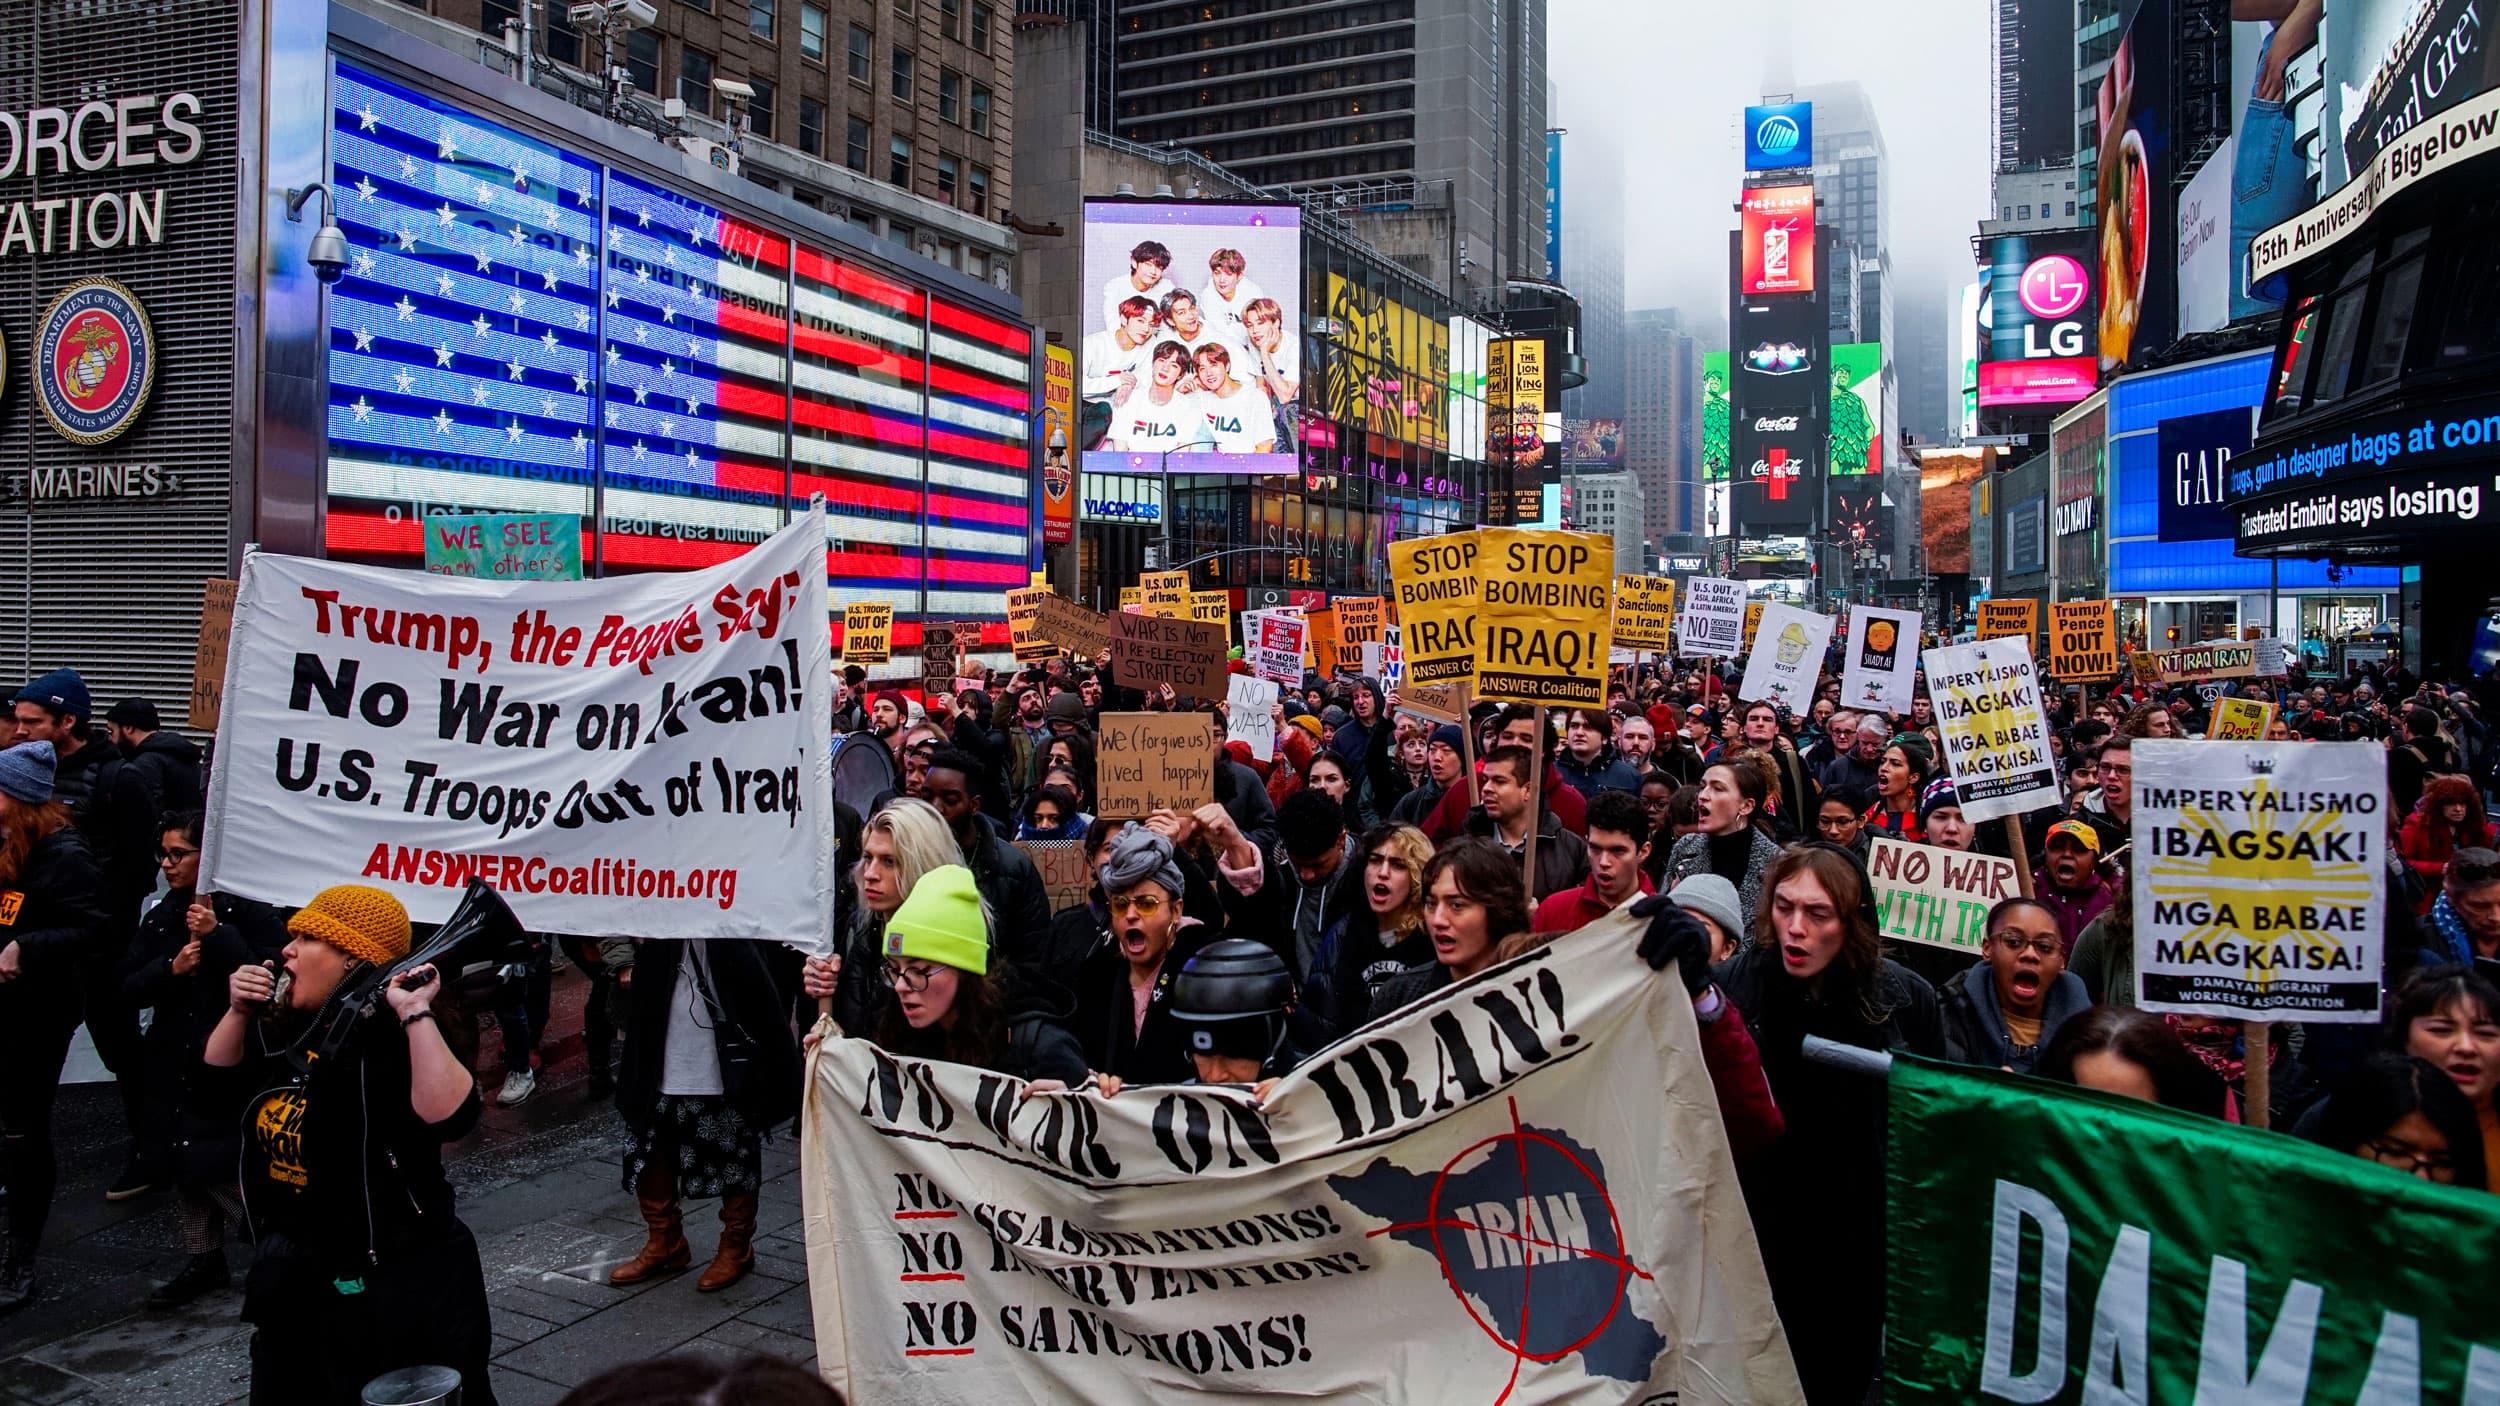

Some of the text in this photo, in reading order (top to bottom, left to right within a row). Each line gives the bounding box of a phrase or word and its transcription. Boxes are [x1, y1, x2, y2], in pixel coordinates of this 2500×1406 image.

[2255, 108, 2500, 269] 75th Anniversary of Bigelow
[2199, 216, 2216, 246] Now
[43, 293, 143, 365] DEPARTMENT OF THE NAVY
[2024, 321, 2084, 358] LG
[1517, 364, 1540, 375] LION
[1519, 353, 1536, 363] THE
[45, 361, 143, 428] UNITED STATES MARINE CORPS
[1515, 377, 1543, 391] KING
[1133, 419, 1177, 437] FILA
[2255, 457, 2275, 492] gun
[2276, 453, 2287, 479] in
[2289, 440, 2348, 479] designer
[2351, 430, 2401, 466] bags
[2407, 419, 2436, 453] at
[31, 464, 162, 499] MARINES
[1084, 498, 1160, 519] VIACOMCBS
[2055, 495, 2094, 537] OLD NAVY
[2241, 481, 2480, 539] Frustrated Embiid says losing
[440, 520, 555, 550] WE SEE
[1046, 531, 1067, 539] MARKET
[1327, 534, 1357, 560] KEY
[494, 553, 564, 576] other's
[1413, 542, 1477, 575] STOP
[1505, 542, 1589, 575] STOP
[1673, 558, 1702, 570] TRULY
[1145, 576, 1184, 590] U.S. OUT
[1485, 579, 1606, 609] BOMBING
[1624, 576, 1670, 592] No War
[1639, 591, 1651, 600] or
[1694, 582, 1740, 596] U.S. OUT of
[848, 605, 891, 614] U.S. TROOPS
[1148, 591, 1181, 604] of Iraq,
[1337, 598, 1380, 612] Trump/
[1618, 597, 1669, 614] Sanctions
[1696, 603, 1712, 611] LATIN
[1712, 605, 1738, 615] AMERICA
[1983, 603, 2033, 616] Trump/
[2054, 602, 2107, 618] Trump/
[848, 615, 889, 629] OUT OF
[1050, 599, 1106, 627] TRUMP
[1341, 613, 1378, 625] Pence
[1618, 614, 1665, 629] on Iran!
[1711, 619, 1738, 628] COUPS
[1986, 617, 2028, 630] Pence
[2059, 618, 2105, 631] Pence
[301, 586, 493, 675] Trump,
[510, 608, 582, 667] the
[583, 602, 705, 676] People
[933, 631, 945, 644] NO
[1118, 615, 1209, 645] WAR IS NOT
[1268, 633, 1295, 644] MILLION
[1344, 625, 1378, 644] OUT
[1626, 629, 1637, 637] Out
[1637, 629, 1643, 637] of
[1686, 615, 1709, 639] NO
[849, 636, 884, 651] IRAQ!
[931, 647, 948, 659] WAR
[1114, 638, 1216, 665] A RE-ELECTION
[1486, 625, 1598, 676] IRAQ!
[2062, 631, 2104, 652] OUT
[1262, 650, 1299, 663] NO MORE
[2054, 652, 2113, 675] NOW!
[2183, 651, 2213, 673] IRAQ
[2213, 648, 2251, 669] IRAN
[930, 664, 949, 677] WITH
[1123, 658, 1207, 687] STRATEGY
[1932, 662, 2030, 692] IMPERYALISMO
[288, 652, 409, 729] No
[438, 677, 560, 750] War
[575, 701, 641, 751] on
[643, 637, 802, 744] Iran!
[930, 680, 949, 693] IRAN
[1239, 681, 1265, 706] NO
[1414, 689, 1449, 708] DEATH
[1479, 676, 1600, 699] ANSWER Coalition
[1940, 685, 2033, 721] IBAGSAK!
[1228, 712, 1270, 738] WAR
[2222, 721, 2260, 737] Don't
[1100, 727, 1127, 752] We
[1188, 724, 1211, 752] us)
[1949, 723, 2041, 754] MGA BABAE
[1101, 757, 1209, 791] lived happily
[1955, 747, 2044, 778] MAGKAISA!
[275, 737, 382, 806] U.S.
[401, 759, 552, 839] Troops
[551, 778, 656, 830] Out
[664, 760, 704, 818] of
[1099, 786, 1200, 815] during the war
[2142, 787, 2378, 815] IMPERYALISMO
[2151, 826, 2368, 863] IBAGSAK!
[361, 841, 738, 910] ANSWERCoalition.org
[1872, 844, 2015, 902] NO WAR
[1871, 886, 1947, 943] WITH
[2153, 900, 2366, 932] MGA BABAE
[2155, 938, 2364, 972] MAGKAISA!
[860, 966, 1582, 1180] NO WAR ON IRAN!
[893, 1172, 953, 1212] NO
[1454, 1191, 1591, 1270] IRAN
[899, 1230, 964, 1274] NO
[904, 1300, 977, 1349] NO
